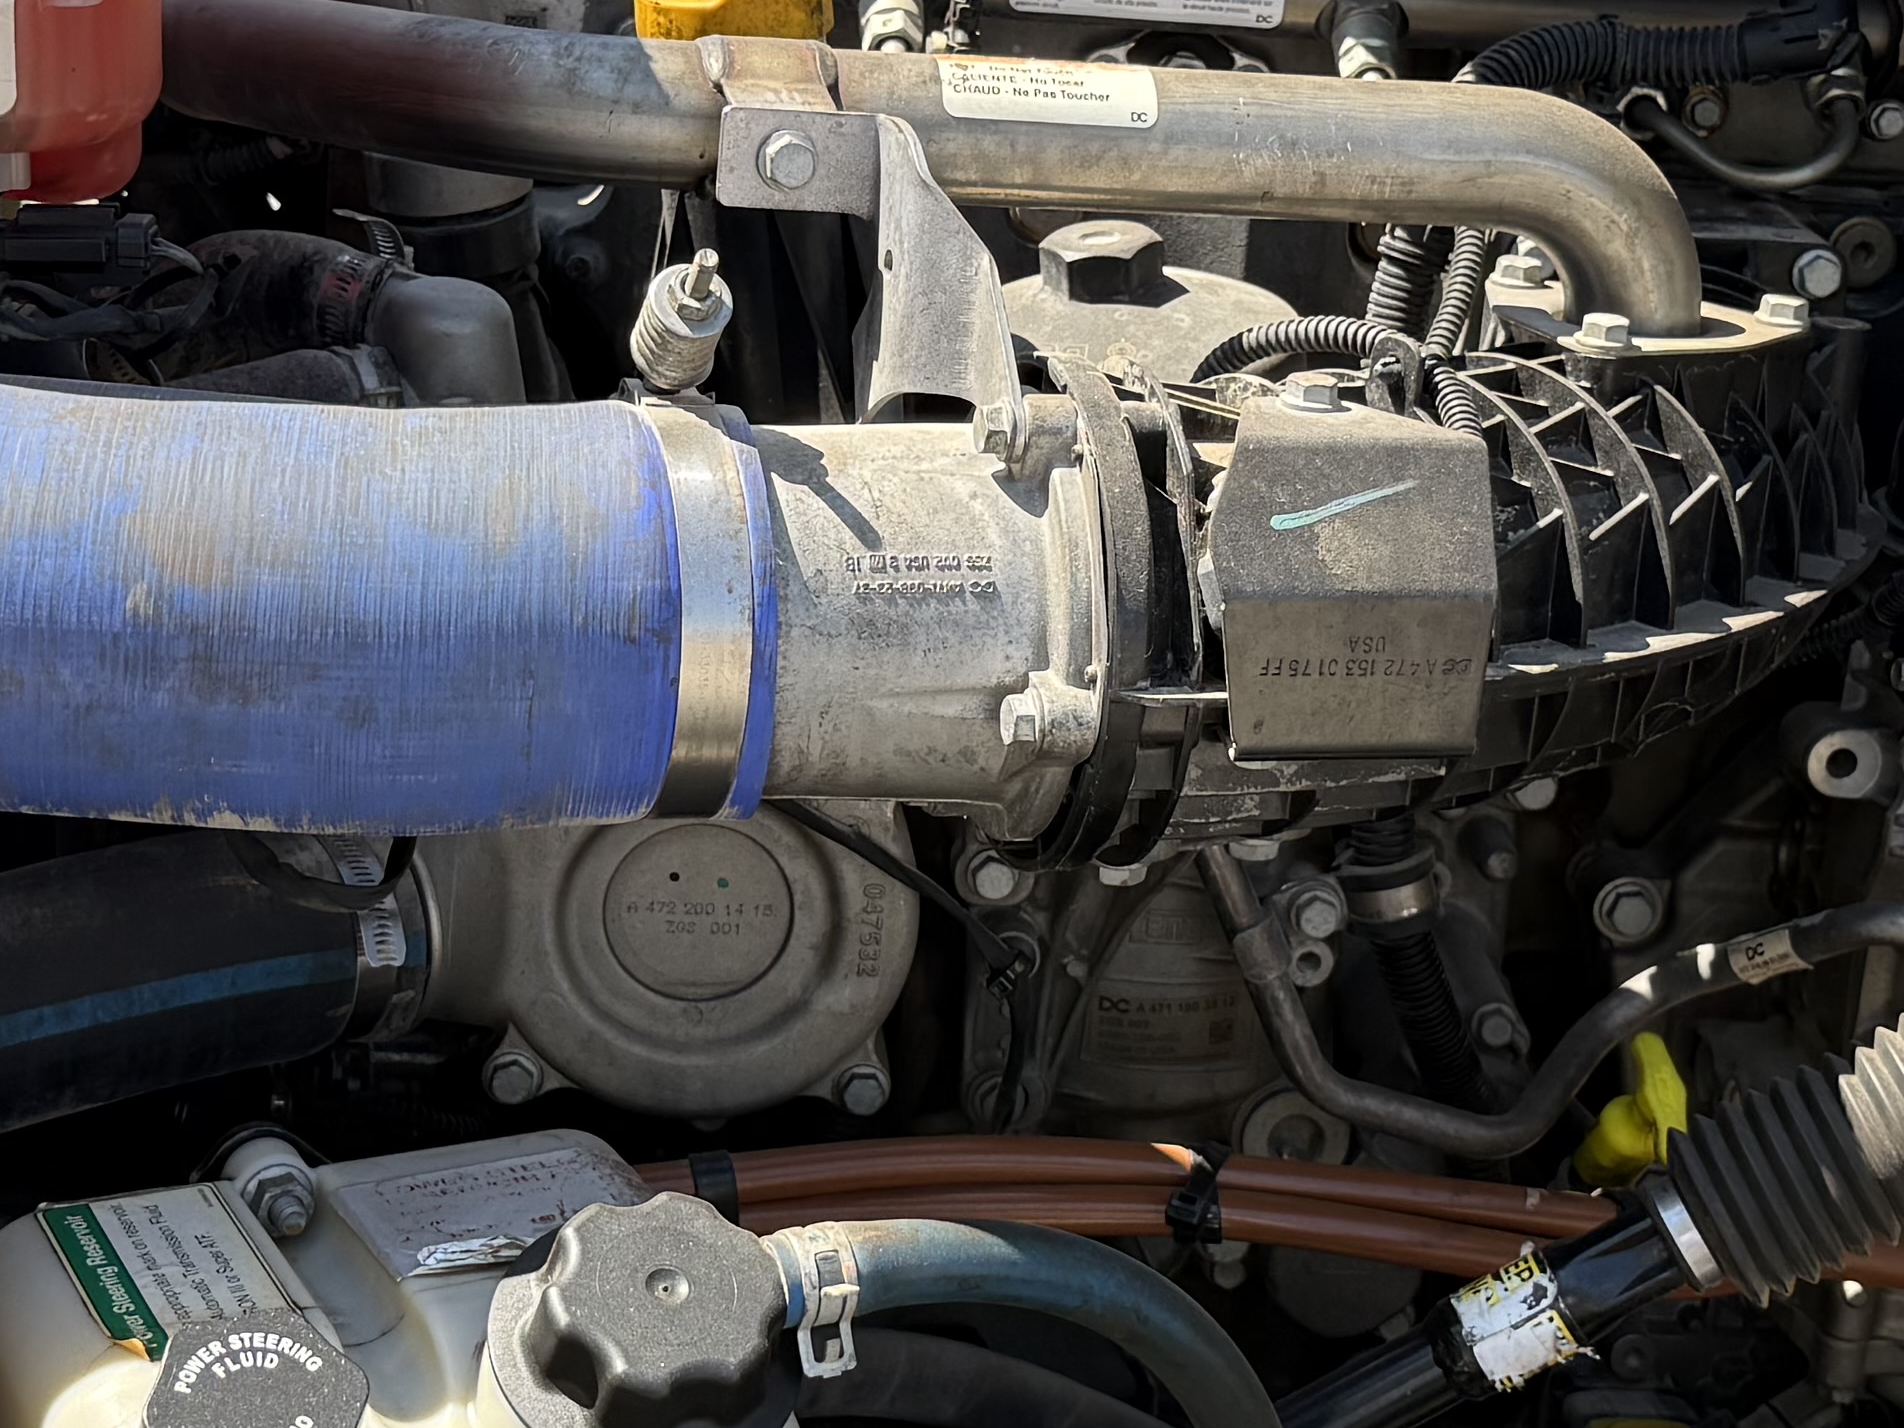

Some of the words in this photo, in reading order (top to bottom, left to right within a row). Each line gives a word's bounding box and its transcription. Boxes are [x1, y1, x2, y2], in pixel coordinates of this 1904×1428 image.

[1256, 15, 1273, 24] DC
[1061, 90, 1110, 102] Toucher
[1131, 112, 1148, 123] DC
[1347, 635, 1386, 654] USA
[1345, 658, 1376, 676] 153
[1383, 658, 1420, 676] 472
[1426, 658, 1437, 676] A
[627, 901, 638, 914] A
[645, 901, 676, 915] 472
[684, 902, 715, 916] 200
[725, 903, 744, 916] 14
[710, 921, 741, 935] 001
[856, 882, 886, 978] 047532
[1745, 942, 1765, 961] DC
[1099, 995, 1130, 1013] DC
[143, 1204, 166, 1226] Fluid
[63, 1214, 108, 1267] Reservoir
[158, 1224, 199, 1279] Transmission
[209, 1247, 233, 1274] Super
[98, 1259, 136, 1314] Steering
[152, 1272, 194, 1327] appropriate
[174, 1340, 226, 1394] POWER
[228, 1332, 323, 1372] STEERING
[212, 1351, 279, 1379] FLUID
